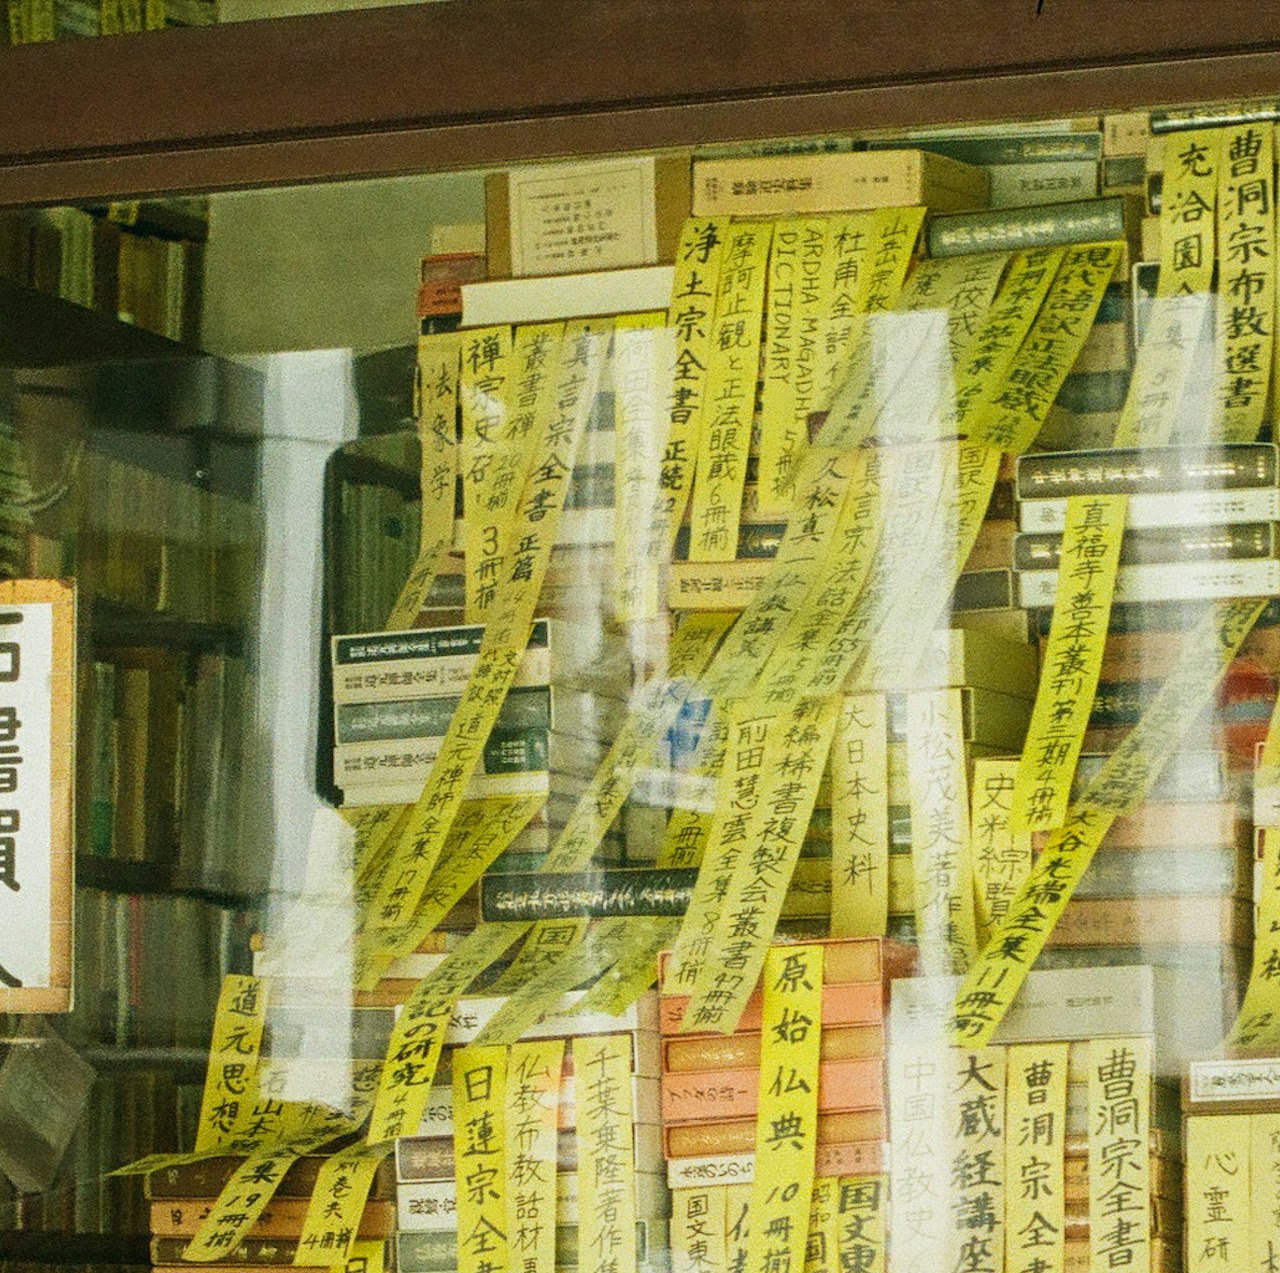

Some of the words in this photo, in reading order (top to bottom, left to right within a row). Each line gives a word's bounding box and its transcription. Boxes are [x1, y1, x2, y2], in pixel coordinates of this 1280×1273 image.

[770, 232, 798, 384] DICTIONARY
[802, 228, 821, 303] ARDHA
[839, 703, 880, 895] 大日本史料
